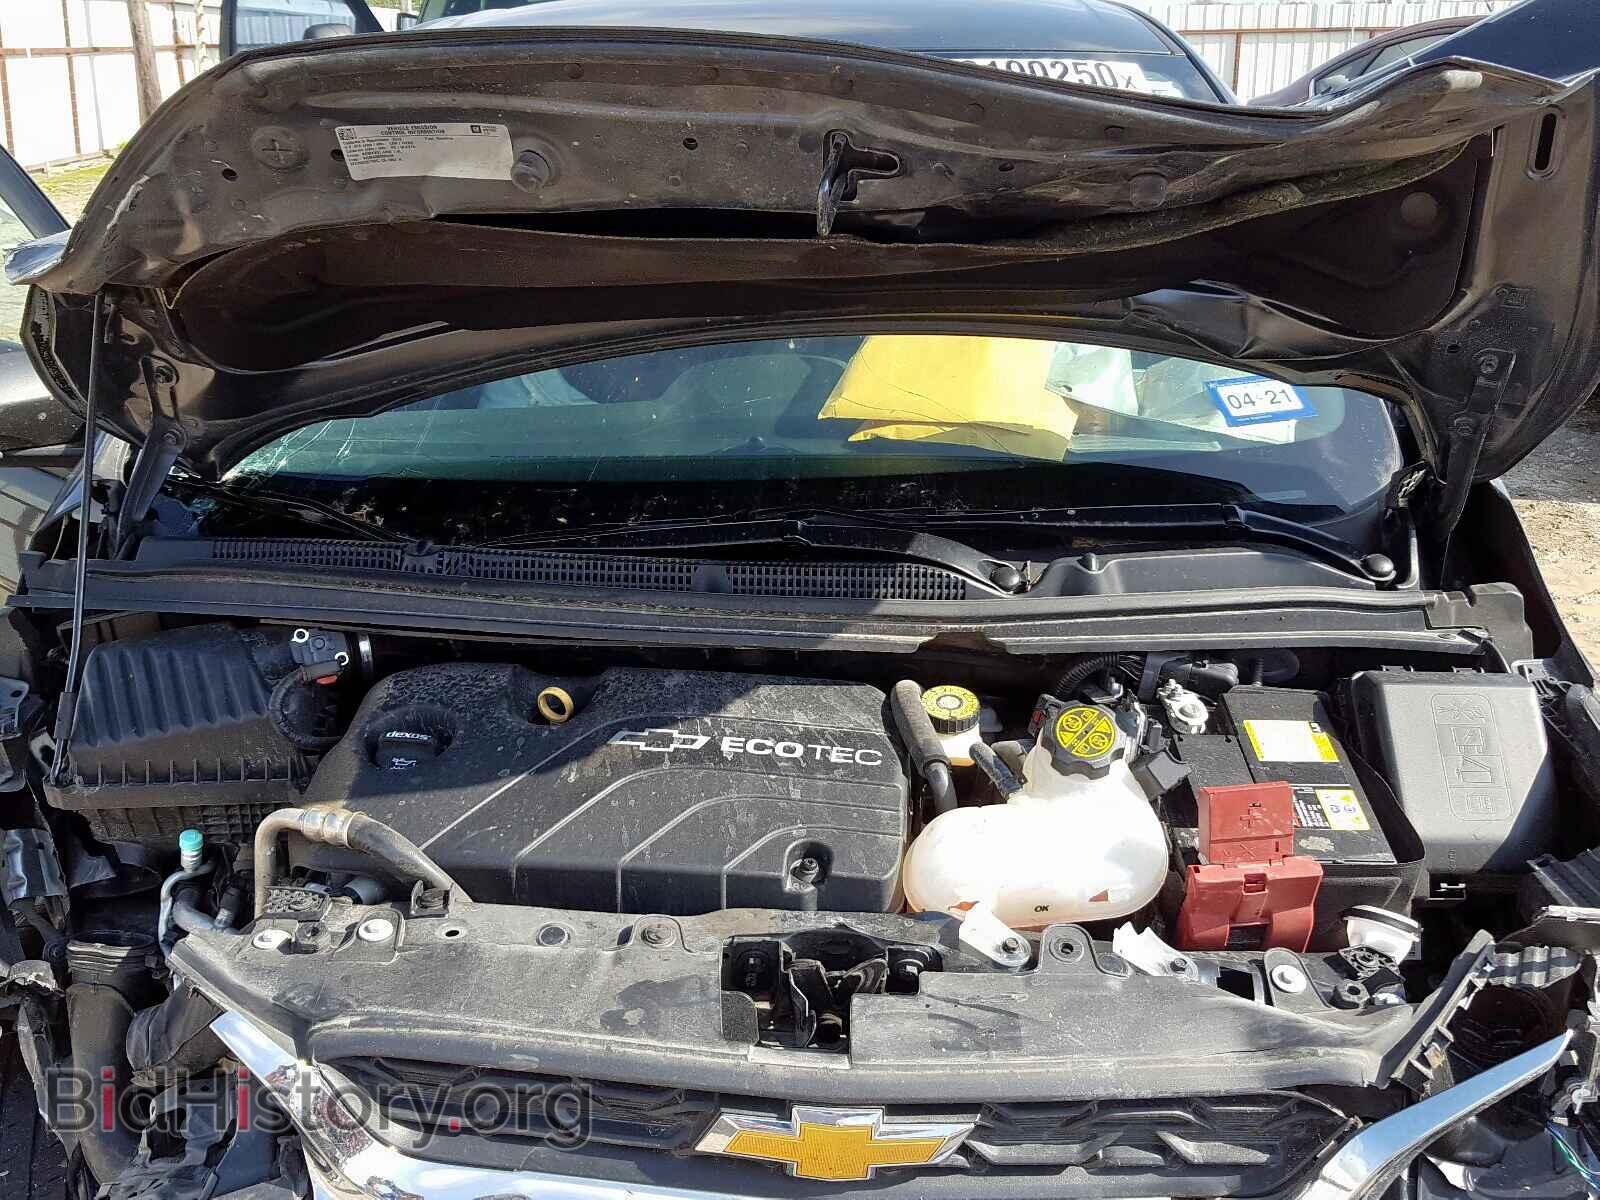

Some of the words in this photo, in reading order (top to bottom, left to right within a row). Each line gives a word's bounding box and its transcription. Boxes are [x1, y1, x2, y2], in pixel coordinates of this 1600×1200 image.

[385, 730, 432, 740] dexos
[720, 736, 883, 766] ECOTEC
[1034, 904, 1050, 913] OK
